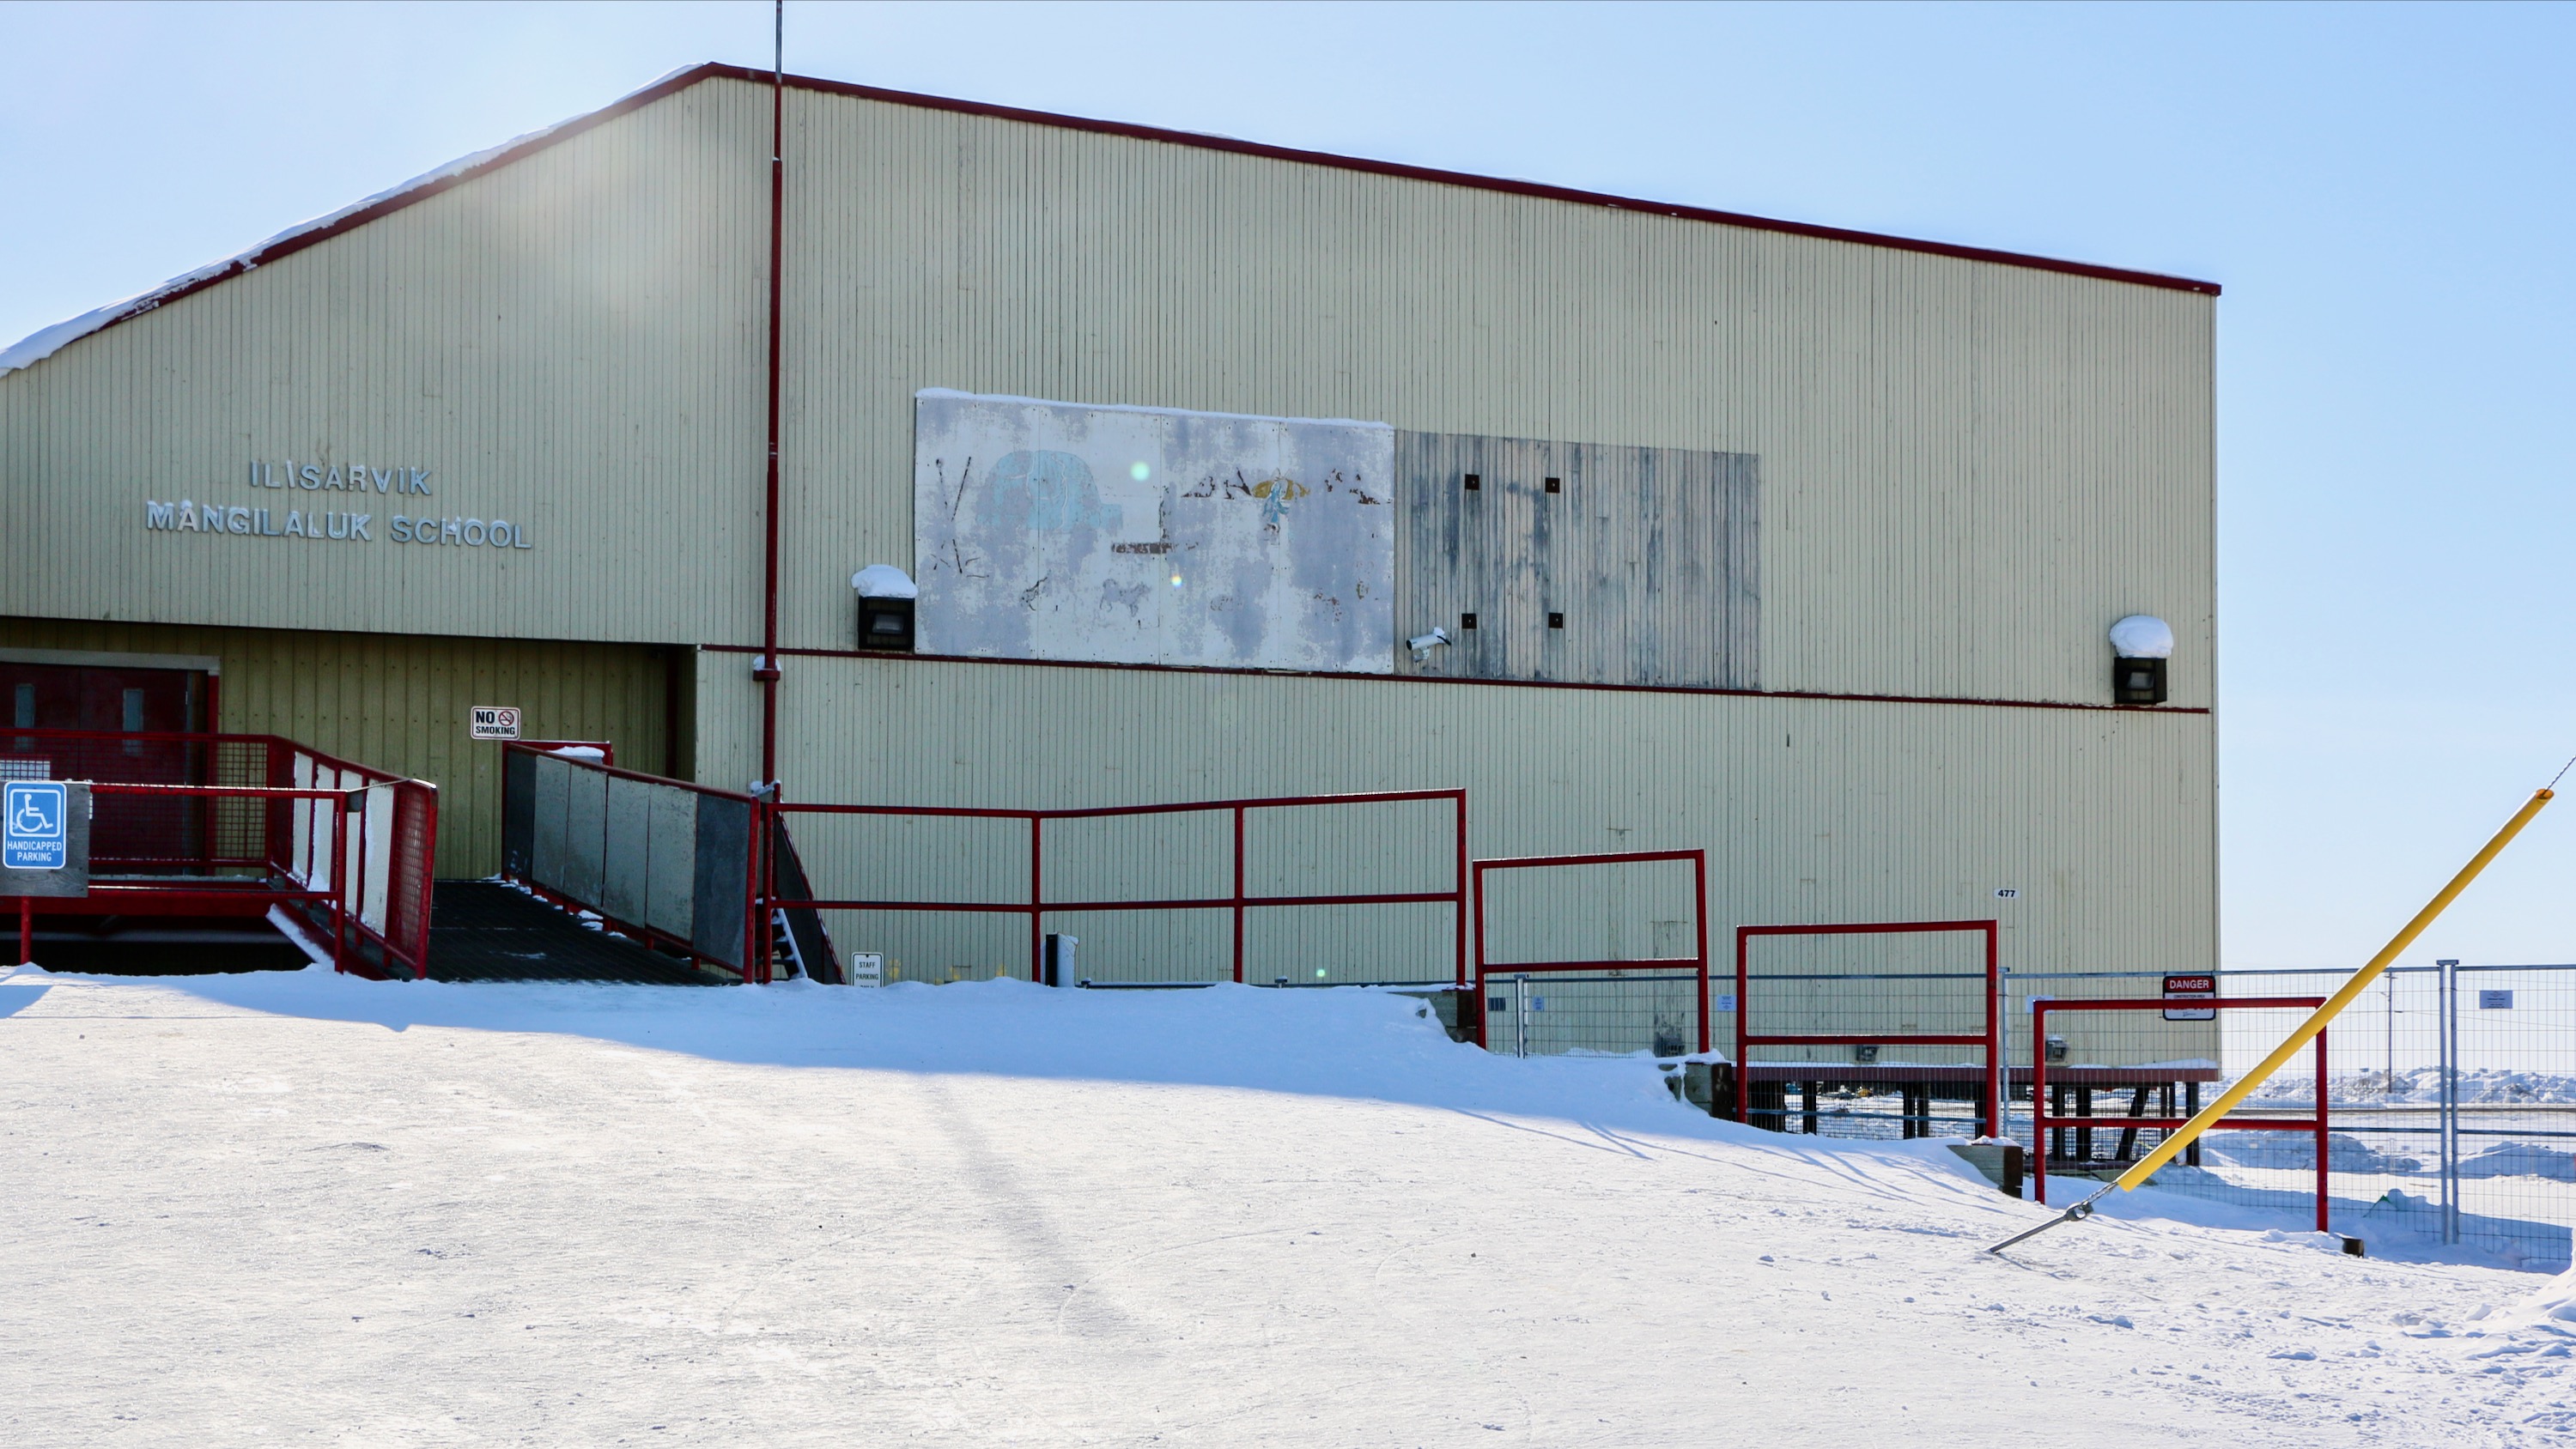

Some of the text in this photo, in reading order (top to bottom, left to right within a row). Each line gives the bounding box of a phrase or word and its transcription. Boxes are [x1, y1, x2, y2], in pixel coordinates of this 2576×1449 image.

[251, 460, 433, 495] ILISARVIK
[147, 500, 532, 549] MANGILALUK SCHOOL
[476, 711, 495, 724] NO
[476, 725, 515, 735] SMOKING
[7, 840, 63, 852] HANDICAPPED
[17, 852, 52, 862] PARKING
[1997, 889, 2016, 898] 477
[2169, 979, 2209, 989] DANGER
